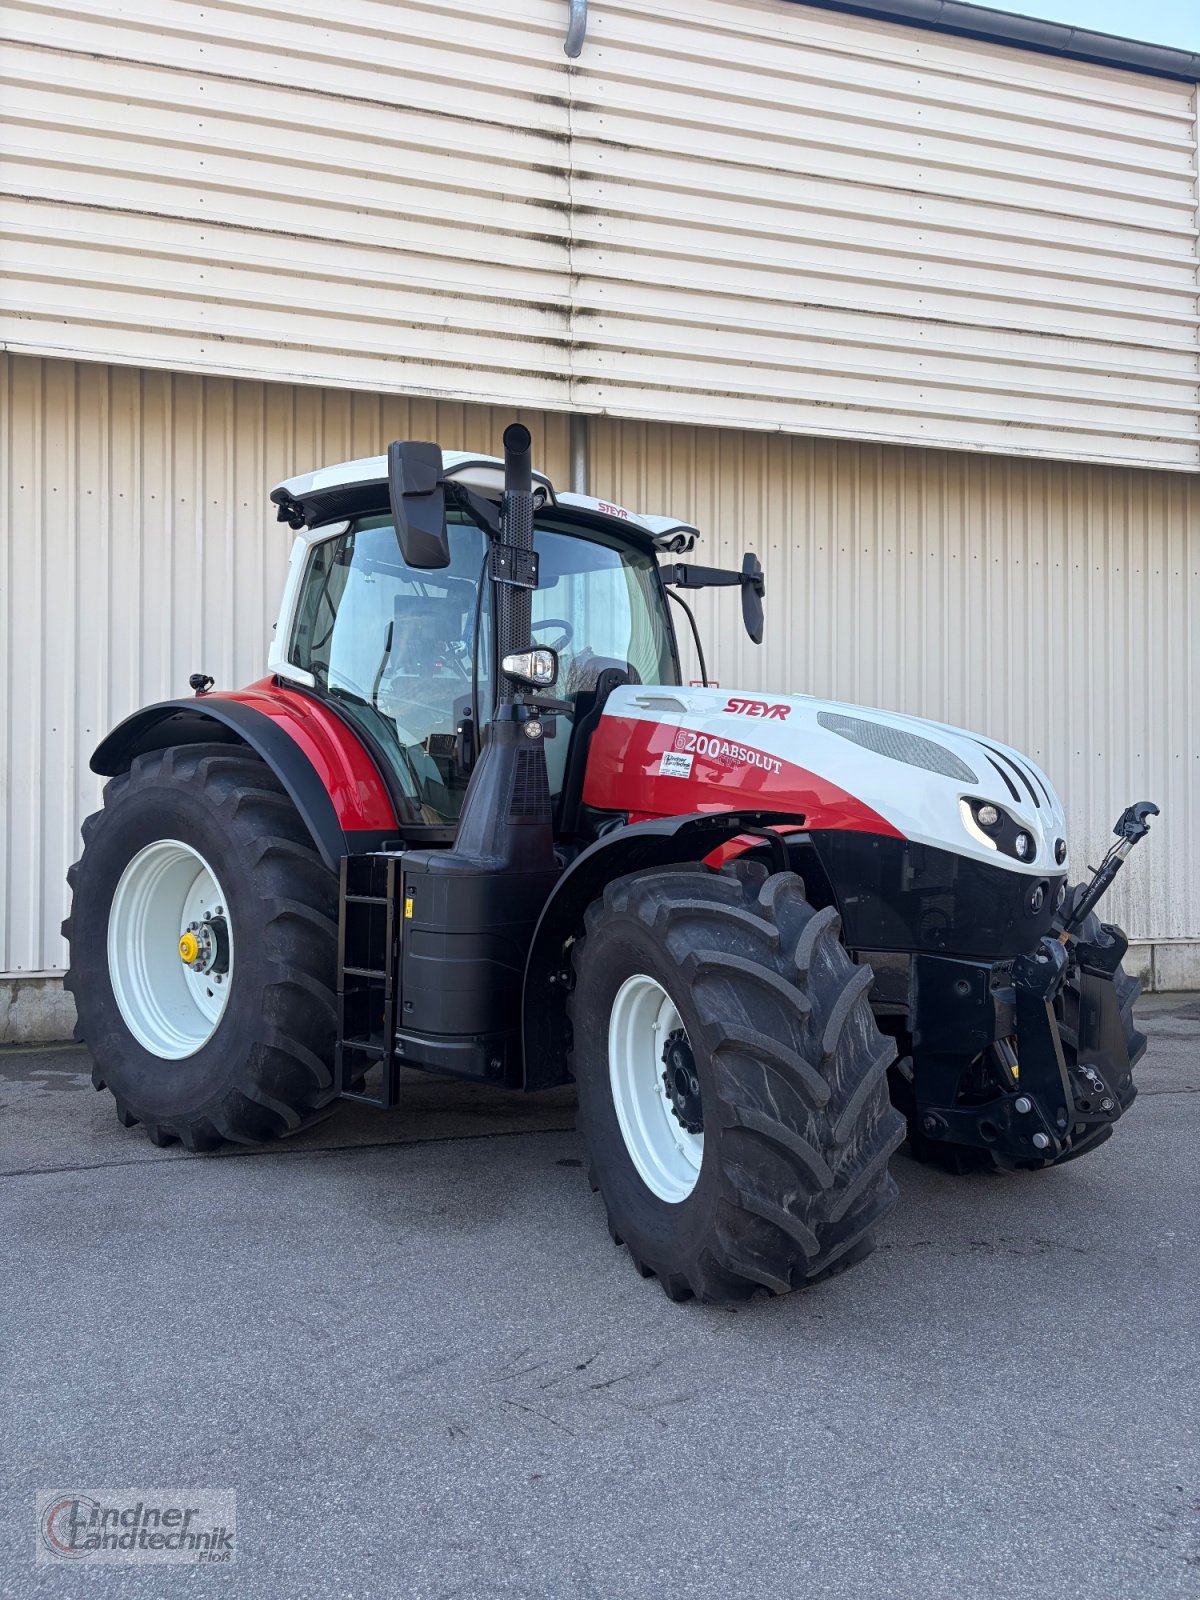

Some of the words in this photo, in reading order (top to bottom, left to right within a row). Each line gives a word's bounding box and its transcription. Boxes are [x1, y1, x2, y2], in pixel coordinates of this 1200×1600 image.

[598, 502, 628, 520] STEYR
[721, 698, 792, 721] STEYR
[674, 730, 720, 758] 6200
[720, 742, 783, 775] ABSOLUT
